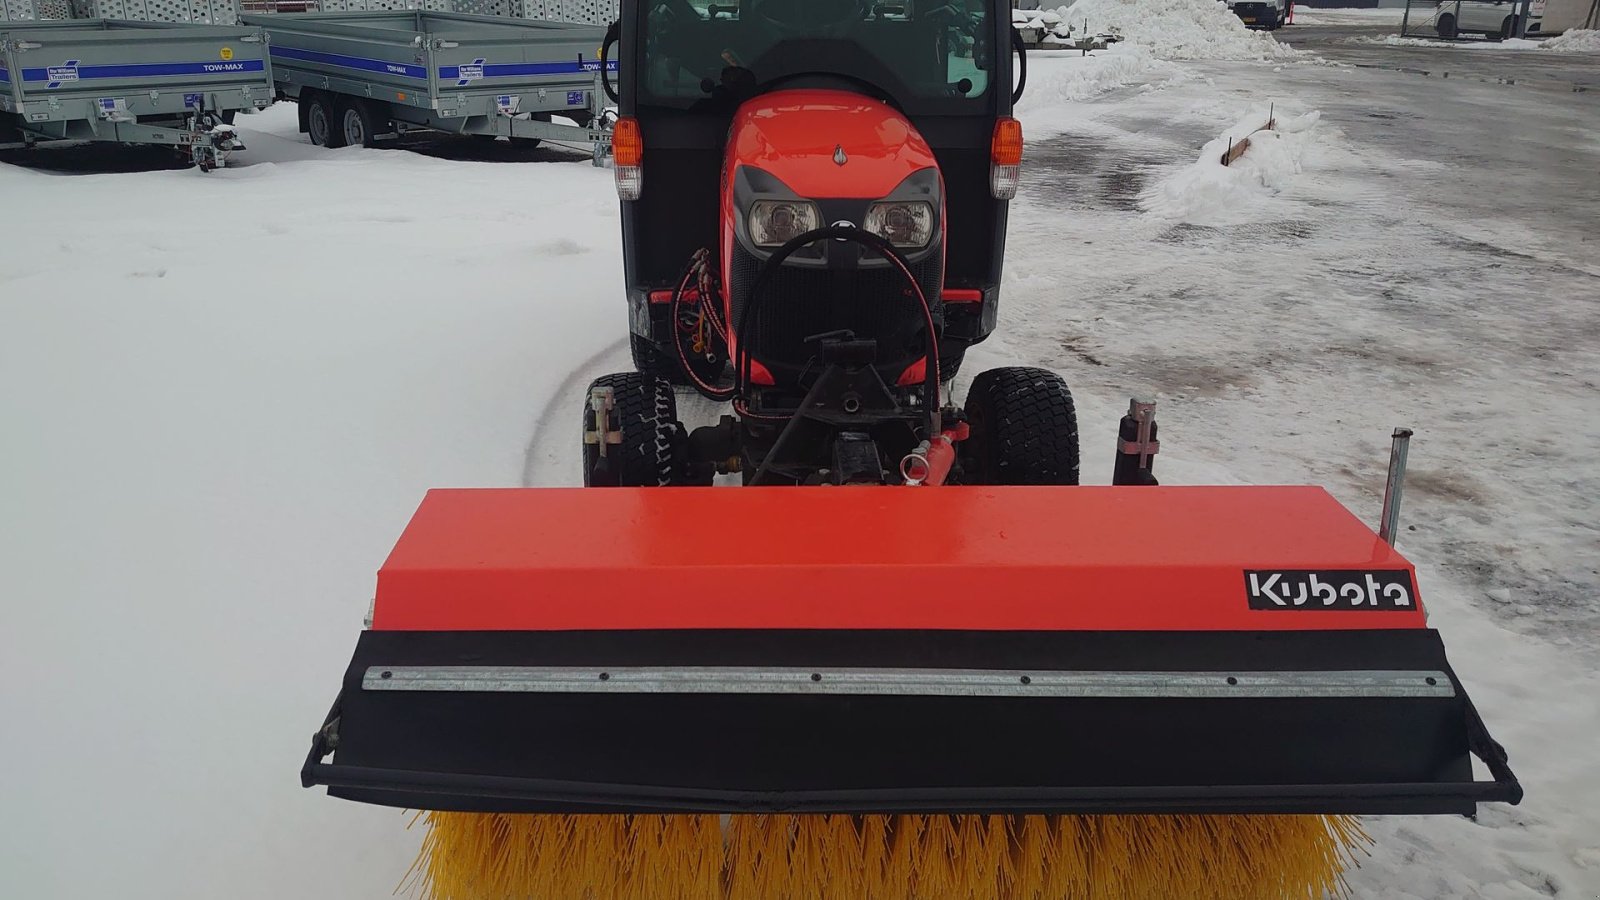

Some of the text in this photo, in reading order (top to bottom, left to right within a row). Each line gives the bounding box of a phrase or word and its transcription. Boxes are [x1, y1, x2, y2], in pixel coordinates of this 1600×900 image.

[203, 63, 244, 71] TOW-MAX
[386, 64, 407, 74] TOW-MAX
[582, 63, 616, 71] TOW-AX
[1250, 573, 1410, 606] Kubota
